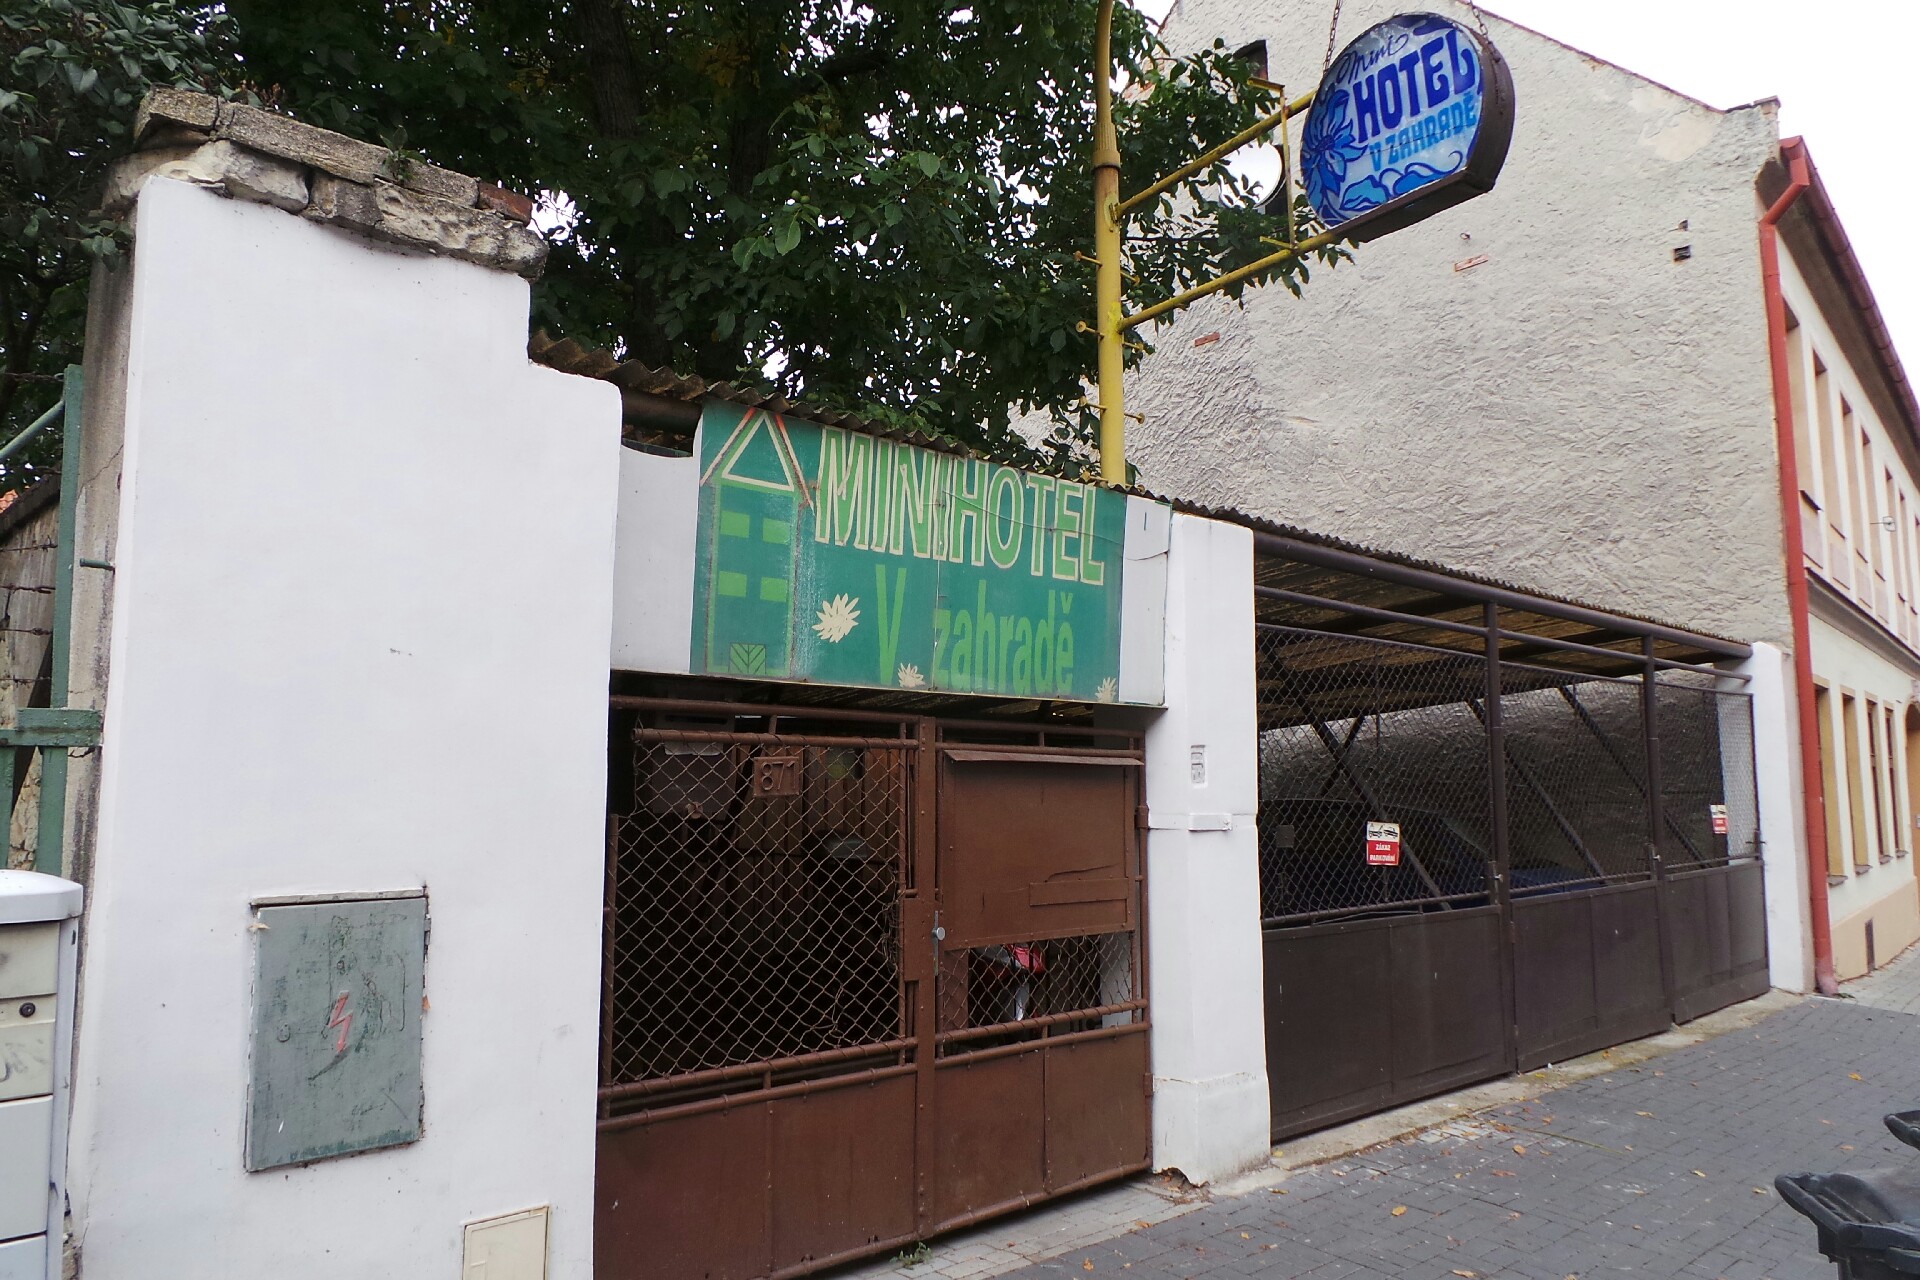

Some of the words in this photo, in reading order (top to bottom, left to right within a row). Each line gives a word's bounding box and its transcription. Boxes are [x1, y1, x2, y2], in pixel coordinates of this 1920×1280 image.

[1353, 28, 1476, 143] HOTEL
[1369, 141, 1382, 172] V
[1385, 91, 1477, 165] ZAHRADĚ
[876, 564, 907, 686] V
[933, 579, 1074, 696] zahradě
[762, 761, 796, 791] 871
